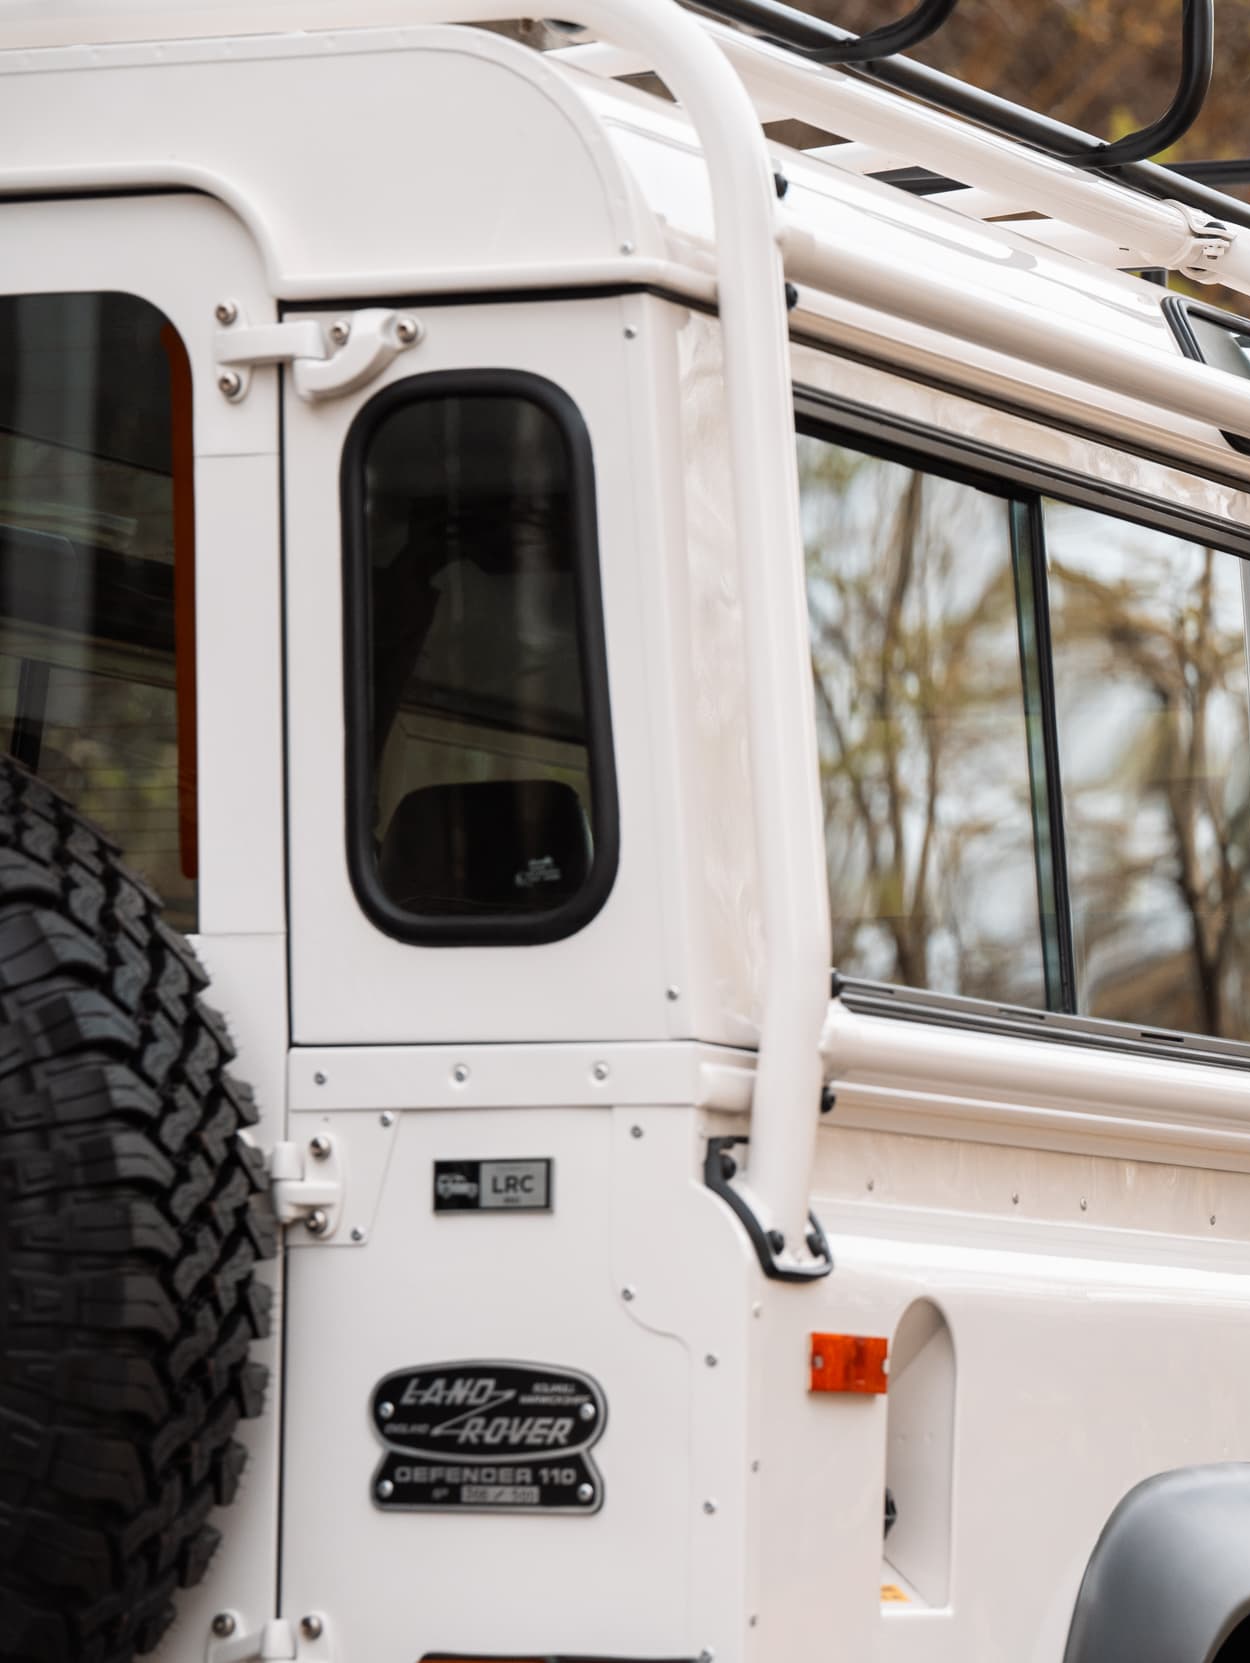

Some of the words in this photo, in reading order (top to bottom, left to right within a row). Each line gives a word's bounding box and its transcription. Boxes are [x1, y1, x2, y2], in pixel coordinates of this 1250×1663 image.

[491, 1174, 534, 1195] LRC
[400, 1377, 497, 1406] LAND
[457, 1417, 575, 1445] ROVER
[394, 1465, 533, 1485] DEFENDER
[538, 1467, 576, 1486] 110
